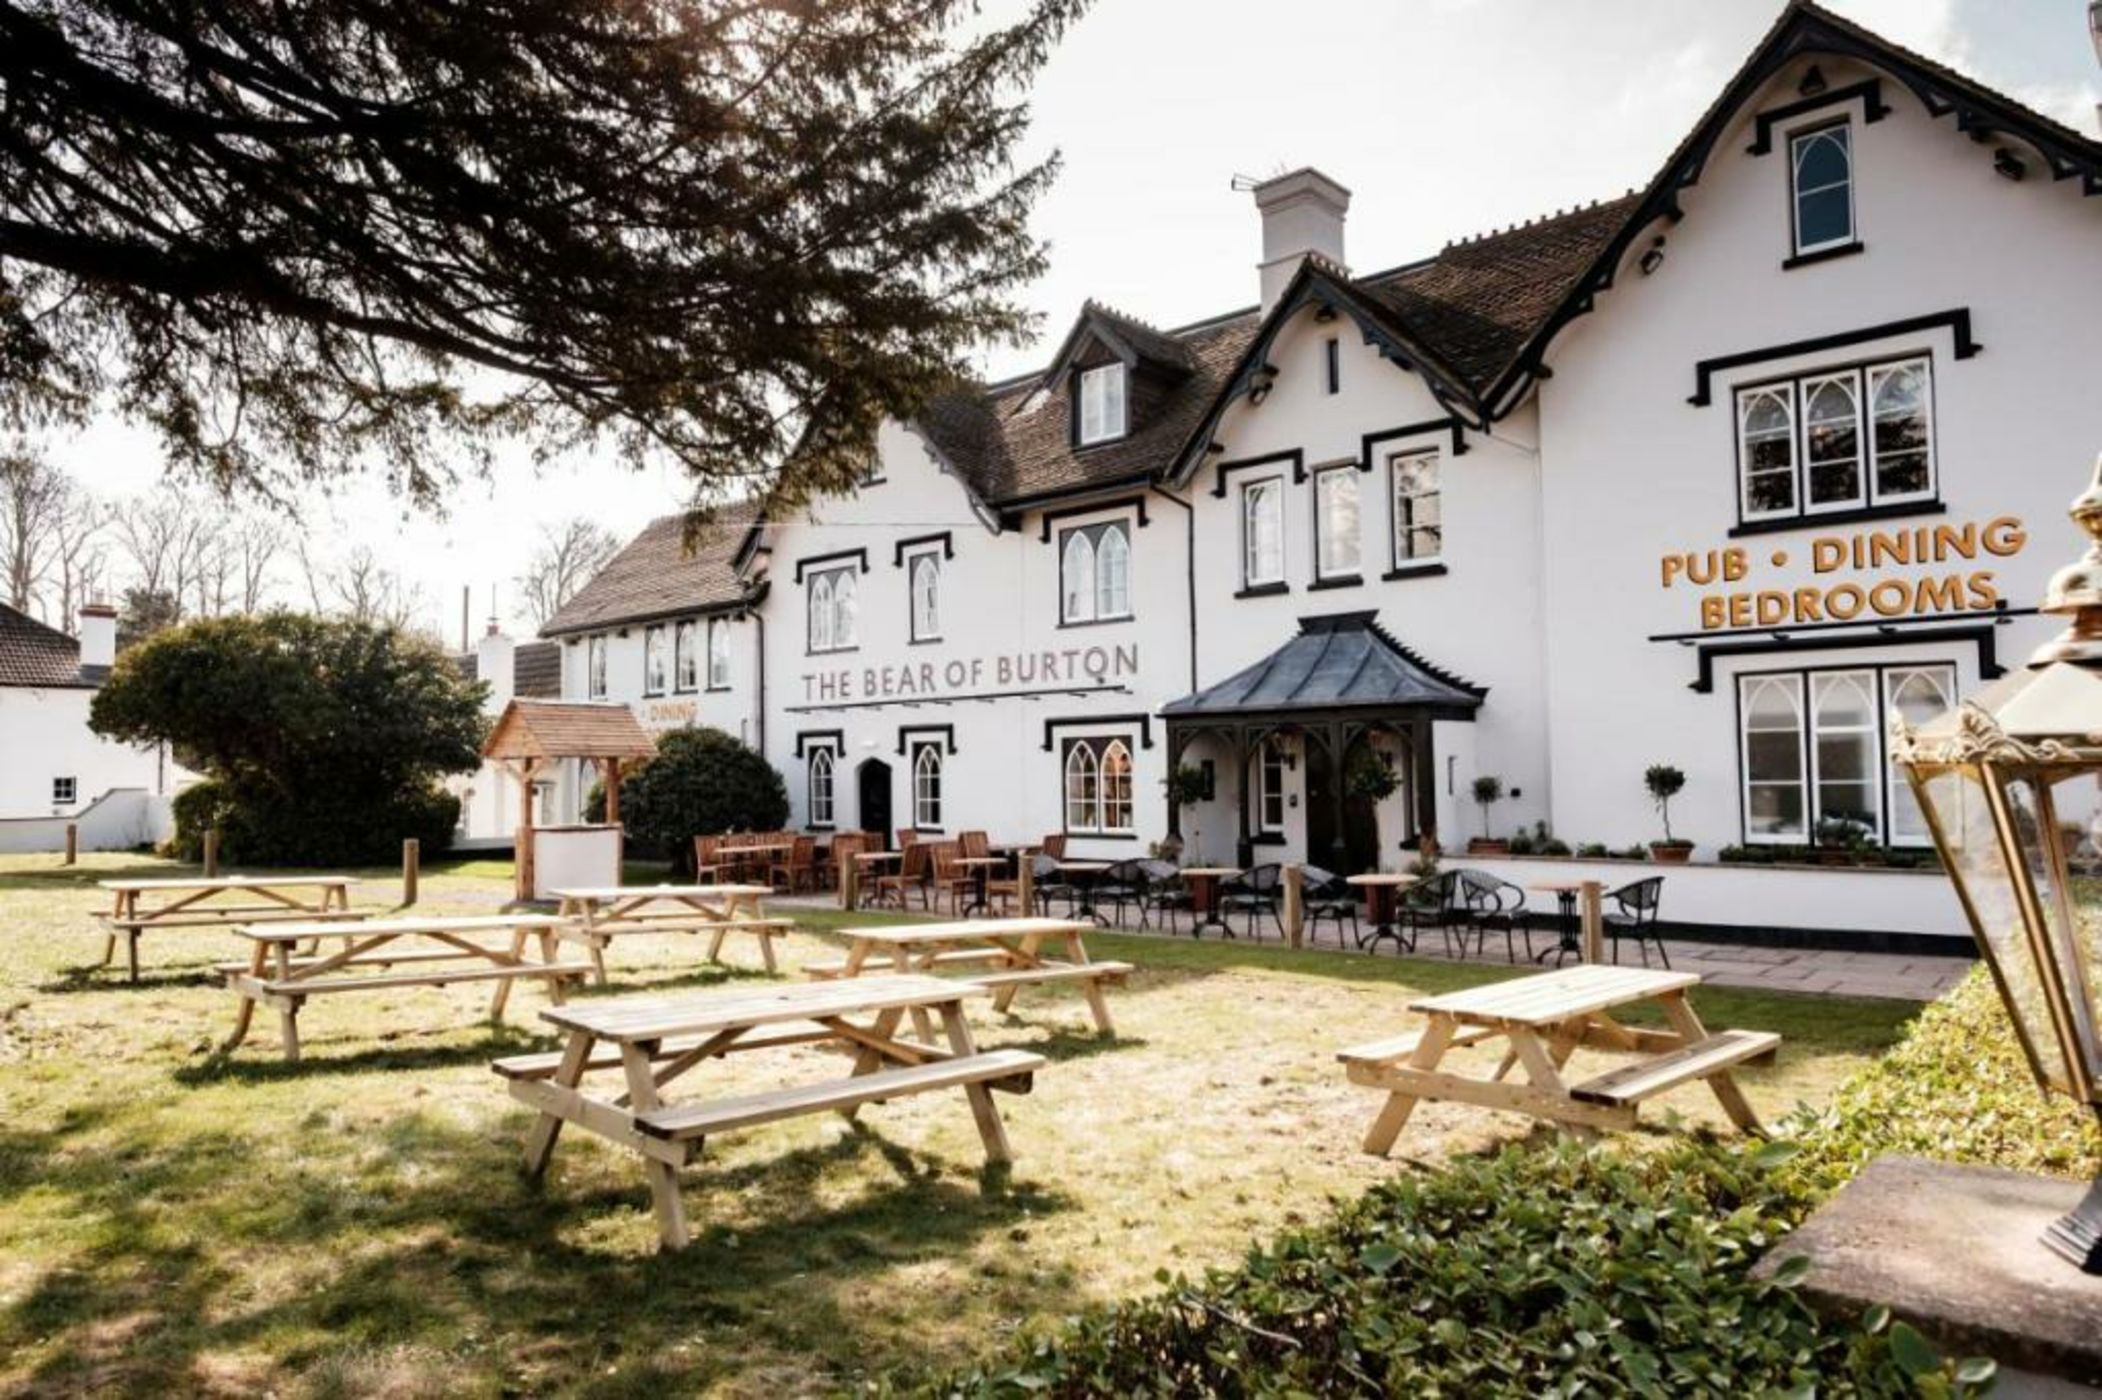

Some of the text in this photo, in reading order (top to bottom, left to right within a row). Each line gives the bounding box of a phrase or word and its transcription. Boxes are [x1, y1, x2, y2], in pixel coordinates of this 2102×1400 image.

[1661, 517, 2026, 587] PUB DINING
[1701, 571, 1998, 629] BEDROOMS
[803, 643, 1138, 702] THE BEAR OF BURTON
[650, 701, 697, 722] DINING
